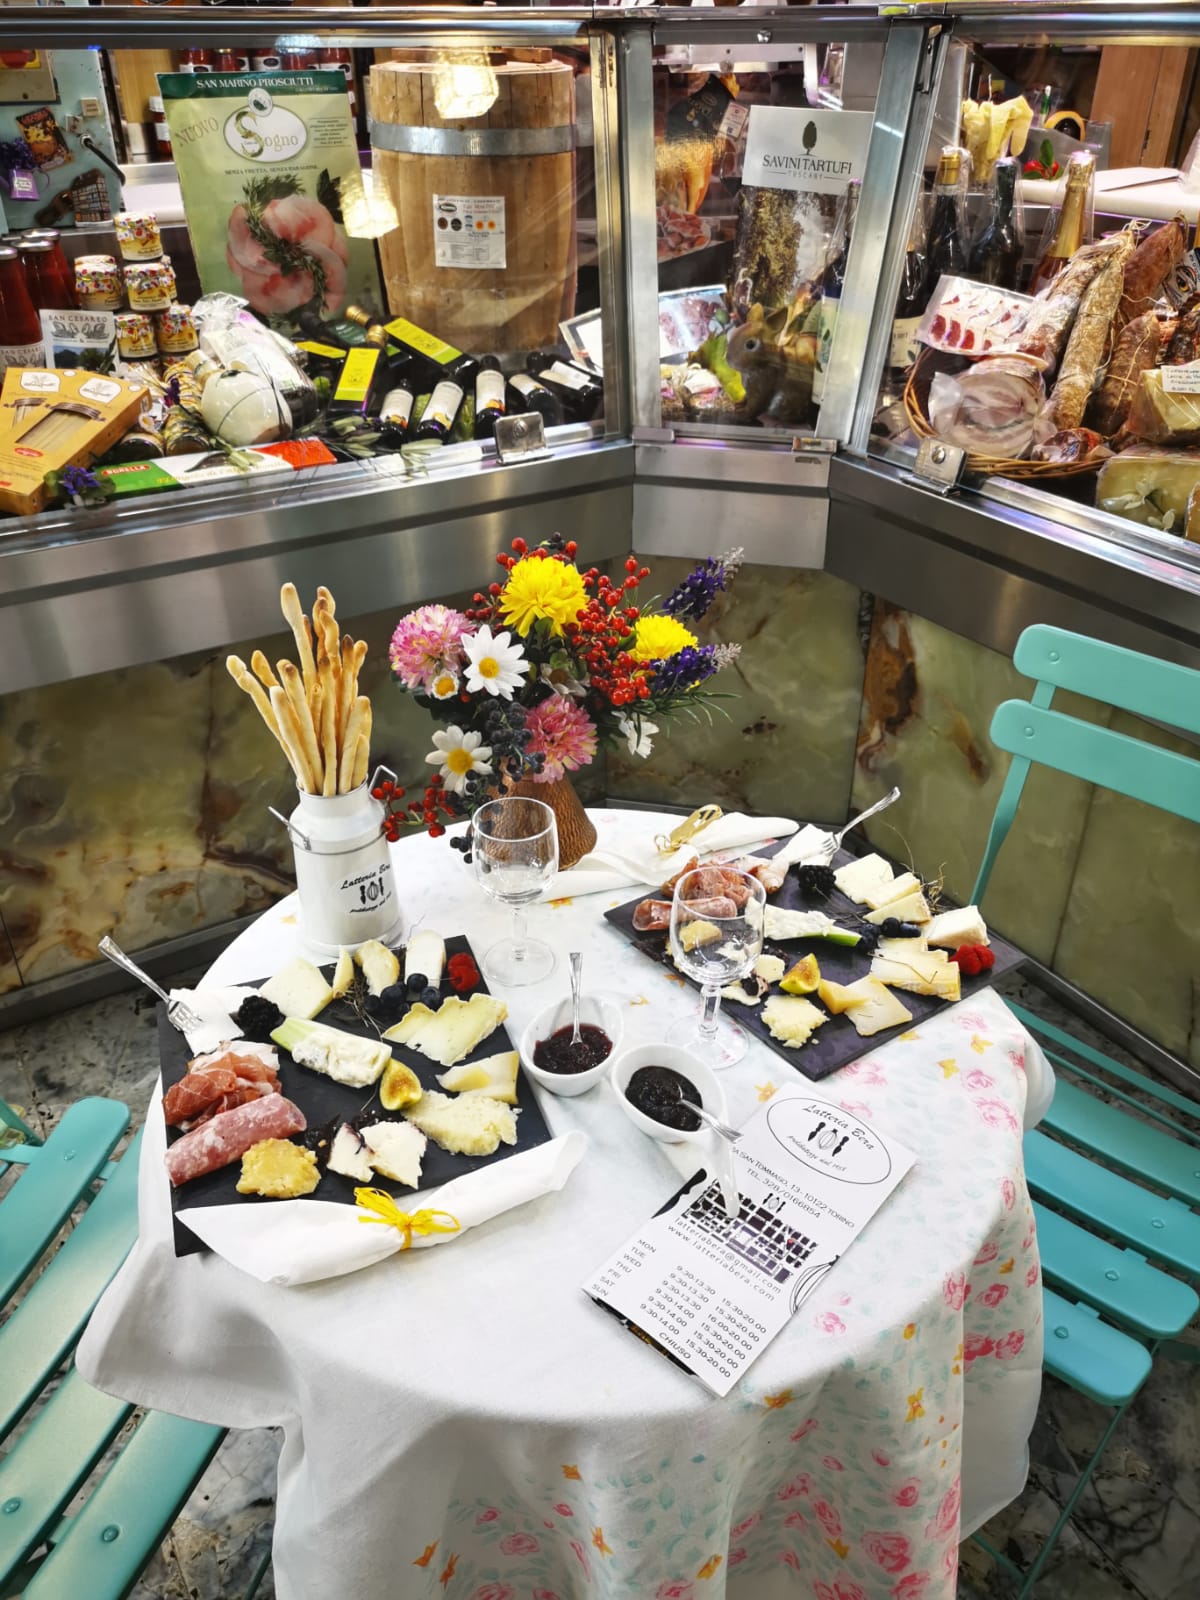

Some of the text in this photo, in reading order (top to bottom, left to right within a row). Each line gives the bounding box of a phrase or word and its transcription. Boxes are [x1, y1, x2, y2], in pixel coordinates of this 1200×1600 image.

[196, 77, 314, 88] SAN MARINO PROSCIUTTI
[175, 117, 219, 146] NUOVO
[235, 111, 299, 158] Sogno
[762, 154, 853, 174] SAVINI TARTUFI
[787, 170, 824, 179] TUSCANY
[68, 315, 108, 323] CESAREO
[803, 1104, 875, 1150] Latteria Bera
[739, 1151, 754, 1162] SAN
[753, 1160, 790, 1187] TOMMASO,
[827, 1207, 855, 1228] TORINO
[762, 1177, 821, 1218] 328/0166854
[637, 1239, 656, 1253] MON
[720, 1298, 767, 1333] 15.30-20.00
[667, 1224, 775, 1300] www.latteriabera.com
[673, 1217, 782, 1294] latteriabera@gmail.com
[592, 1283, 692, 1359] SUN CHIUSO
[600, 1276, 614, 1287] SAT
[684, 1339, 732, 1377] 15.30-20.00
[607, 1268, 620, 1278] FRI
[692, 1330, 739, 1368] 15.30-20.00
[615, 1260, 631, 1273] THU
[699, 1322, 746, 1359] 15.30-20.00
[623, 1253, 642, 1267] WED
[706, 1314, 753, 1350] 16.00-20.00
[630, 1246, 645, 1258] TUE
[713, 1306, 760, 1342] 15.30-20.00
